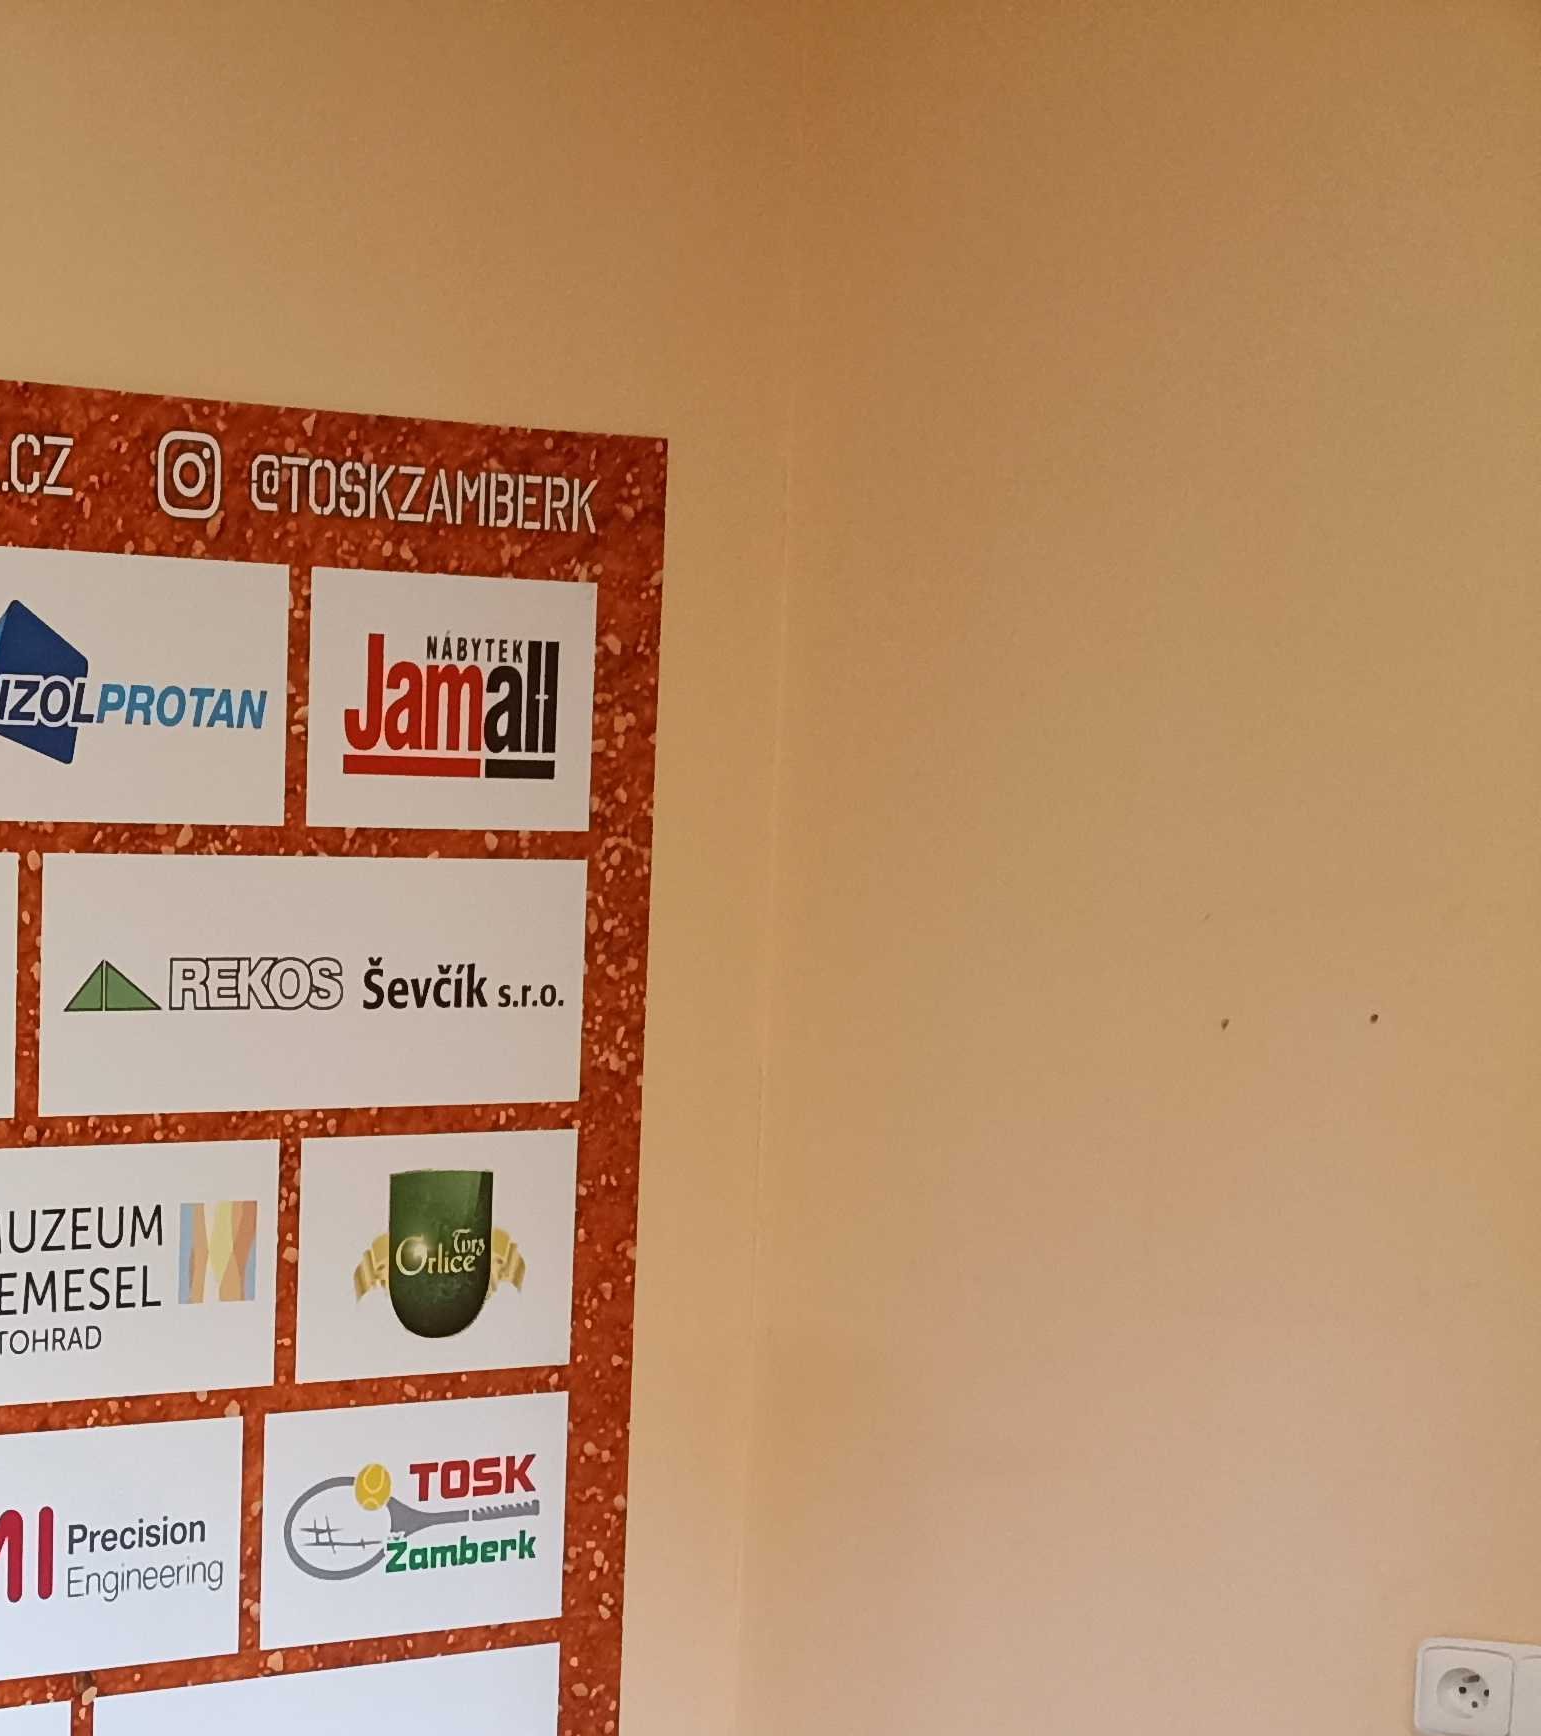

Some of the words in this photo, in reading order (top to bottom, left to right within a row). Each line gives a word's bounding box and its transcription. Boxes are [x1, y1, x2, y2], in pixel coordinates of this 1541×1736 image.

[250, 453, 599, 534] @TOSKZAMBERK
[426, 628, 524, 664] NÁBYTEK
[342, 633, 560, 755] Jamall
[167, 956, 344, 1011] REKOS
[362, 957, 488, 1010] Ševčík
[497, 981, 566, 1009] s.r.o.
[395, 1234, 477, 1276] Orlice
[409, 1453, 536, 1502] TOSK
[66, 1514, 207, 1555] Precision
[384, 1528, 537, 1573] Žamberk
[65, 1555, 225, 1603] Engineering
